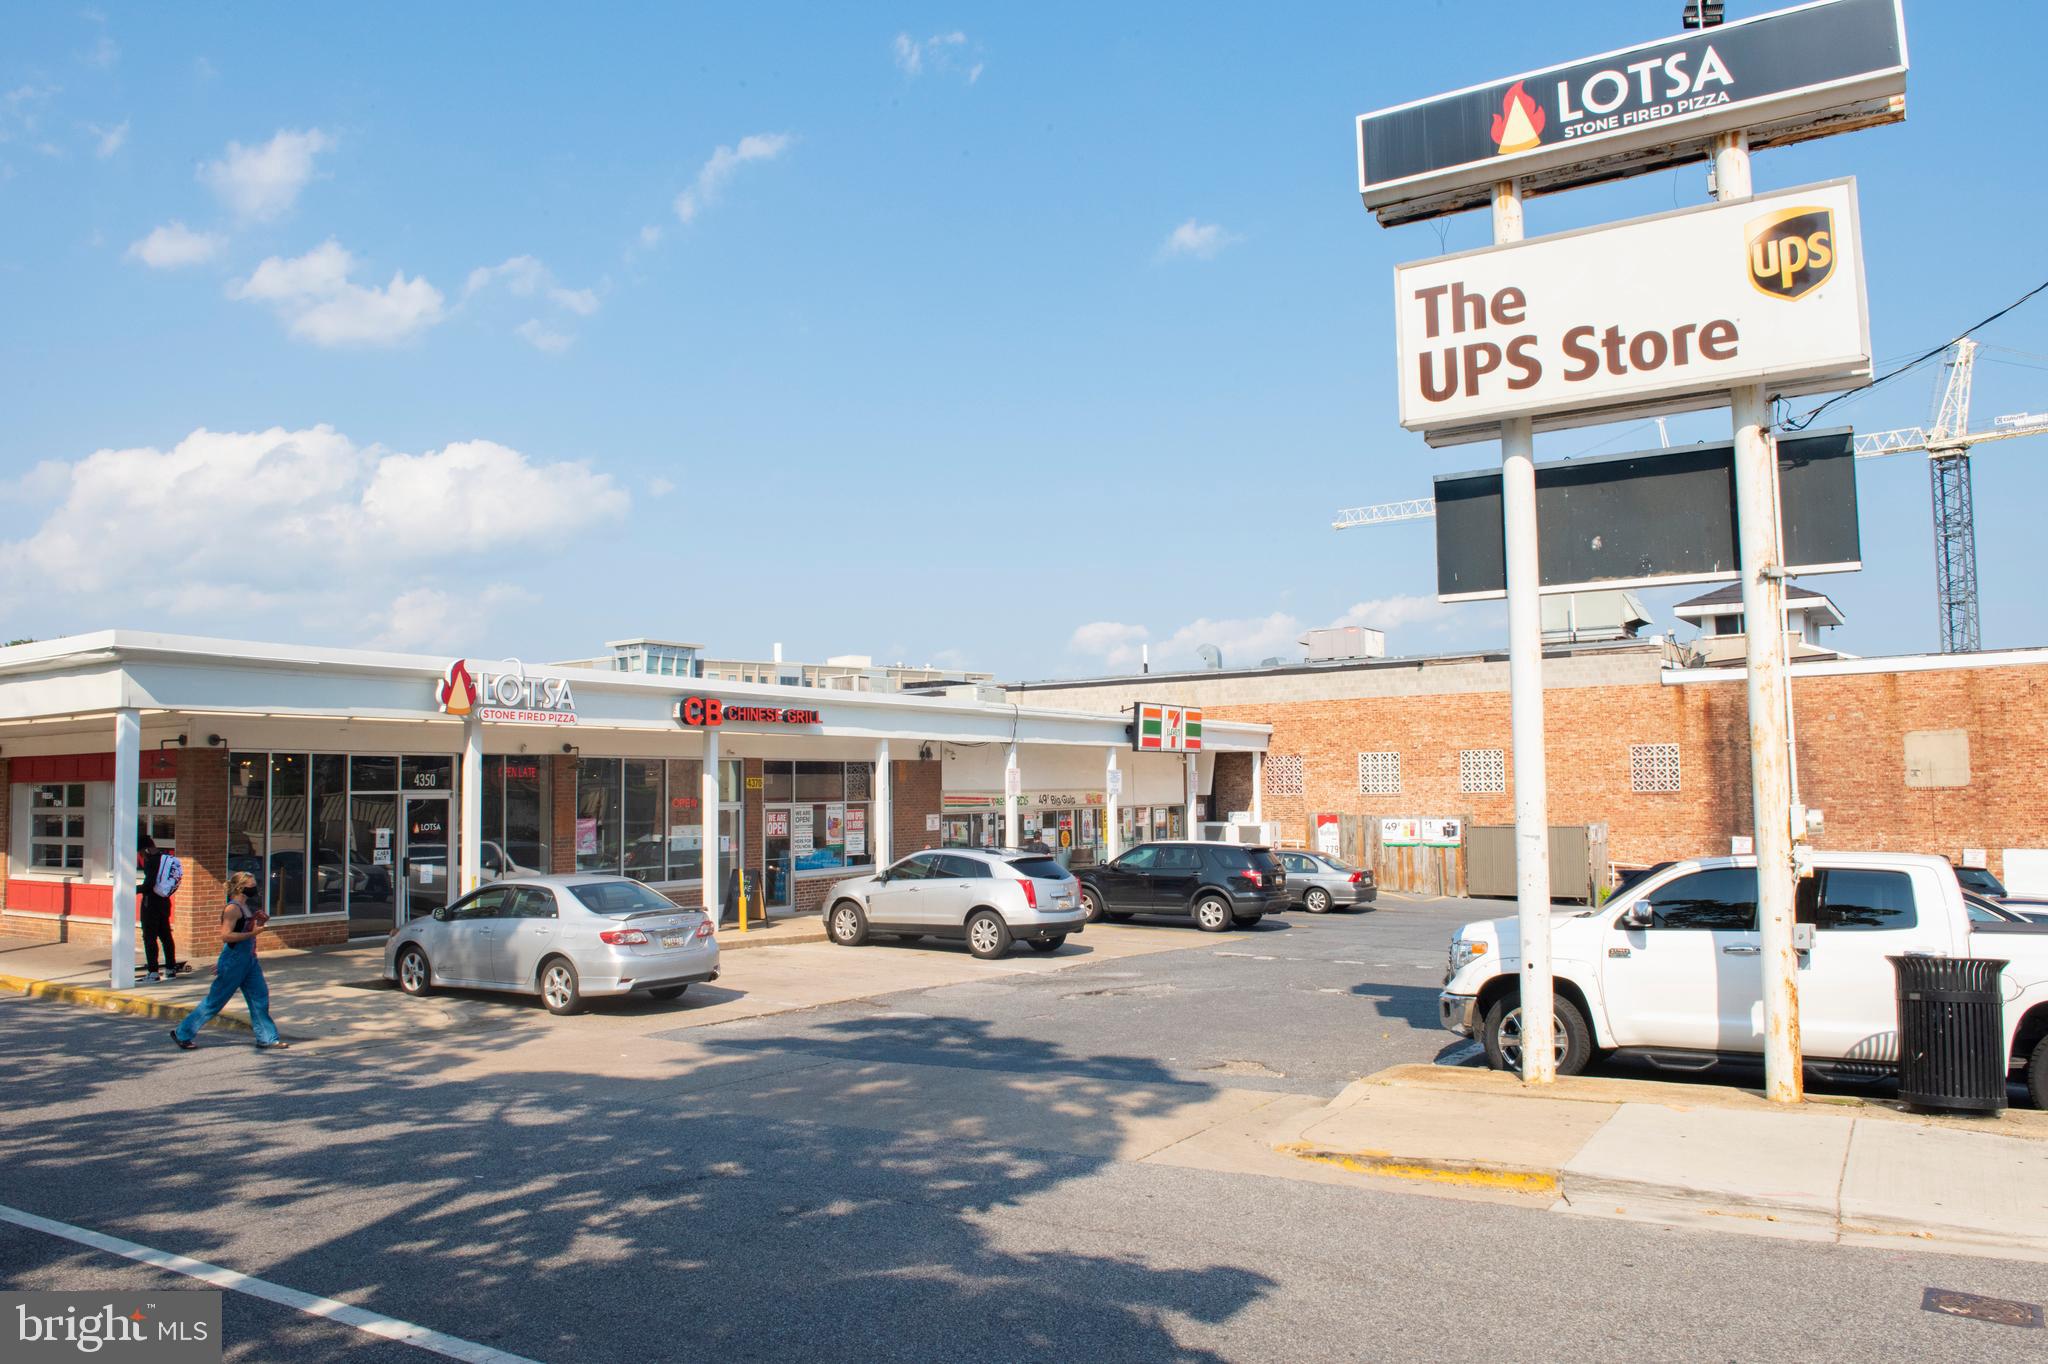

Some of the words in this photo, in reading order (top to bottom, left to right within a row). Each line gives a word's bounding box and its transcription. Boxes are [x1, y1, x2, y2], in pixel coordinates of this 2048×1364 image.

[1558, 46, 1734, 124] LOTSA
[1564, 113, 1620, 139] STONE
[1623, 102, 1673, 128] FIRED
[1677, 91, 1731, 115] PIZZA
[1752, 229, 1833, 289] ups
[1415, 281, 1527, 338] The
[1419, 335, 1542, 402] UPS
[1563, 318, 1739, 382] Store
[482, 673, 576, 710] LOTSA
[483, 709, 516, 720] STONE
[518, 711, 547, 721] FIRED
[549, 713, 576, 723] PIZZA
[684, 696, 722, 726] CB
[728, 706, 783, 722] CHINESE
[787, 709, 823, 724] GRILL
[414, 773, 436, 787] 4350
[498, 767, 517, 778] OEN
[155, 789, 176, 806] PIZZ
[768, 814, 776, 822] WE
[777, 814, 786, 822] ARE
[768, 821, 788, 835] OPEN
